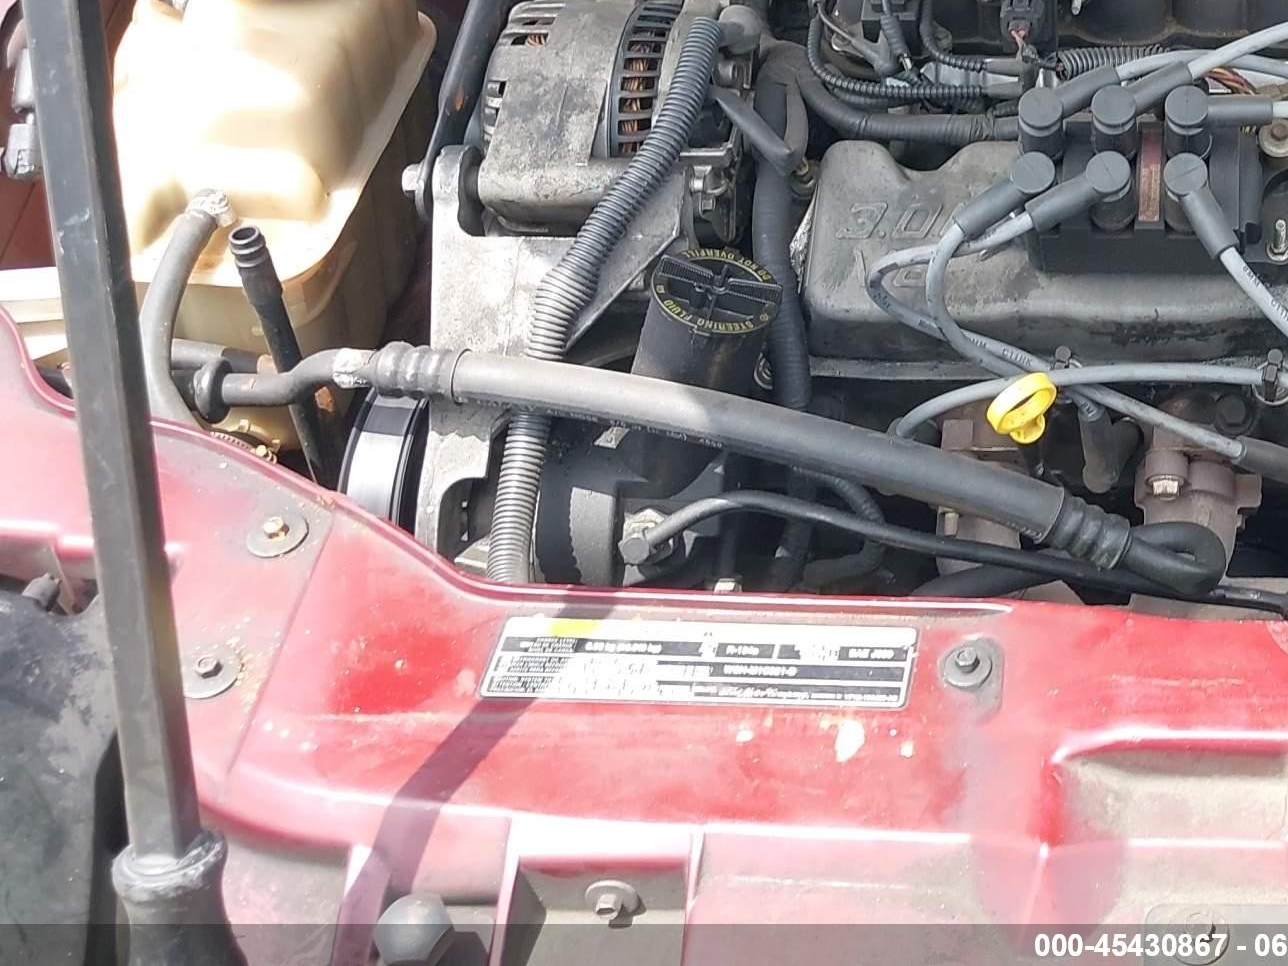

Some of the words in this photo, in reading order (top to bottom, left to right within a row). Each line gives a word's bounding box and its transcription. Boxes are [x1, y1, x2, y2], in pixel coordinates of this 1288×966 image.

[682, 248, 735, 260] OVERFILL
[738, 257, 758, 271] NOT
[663, 299, 693, 323] FLUID
[696, 318, 754, 331] STEERING
